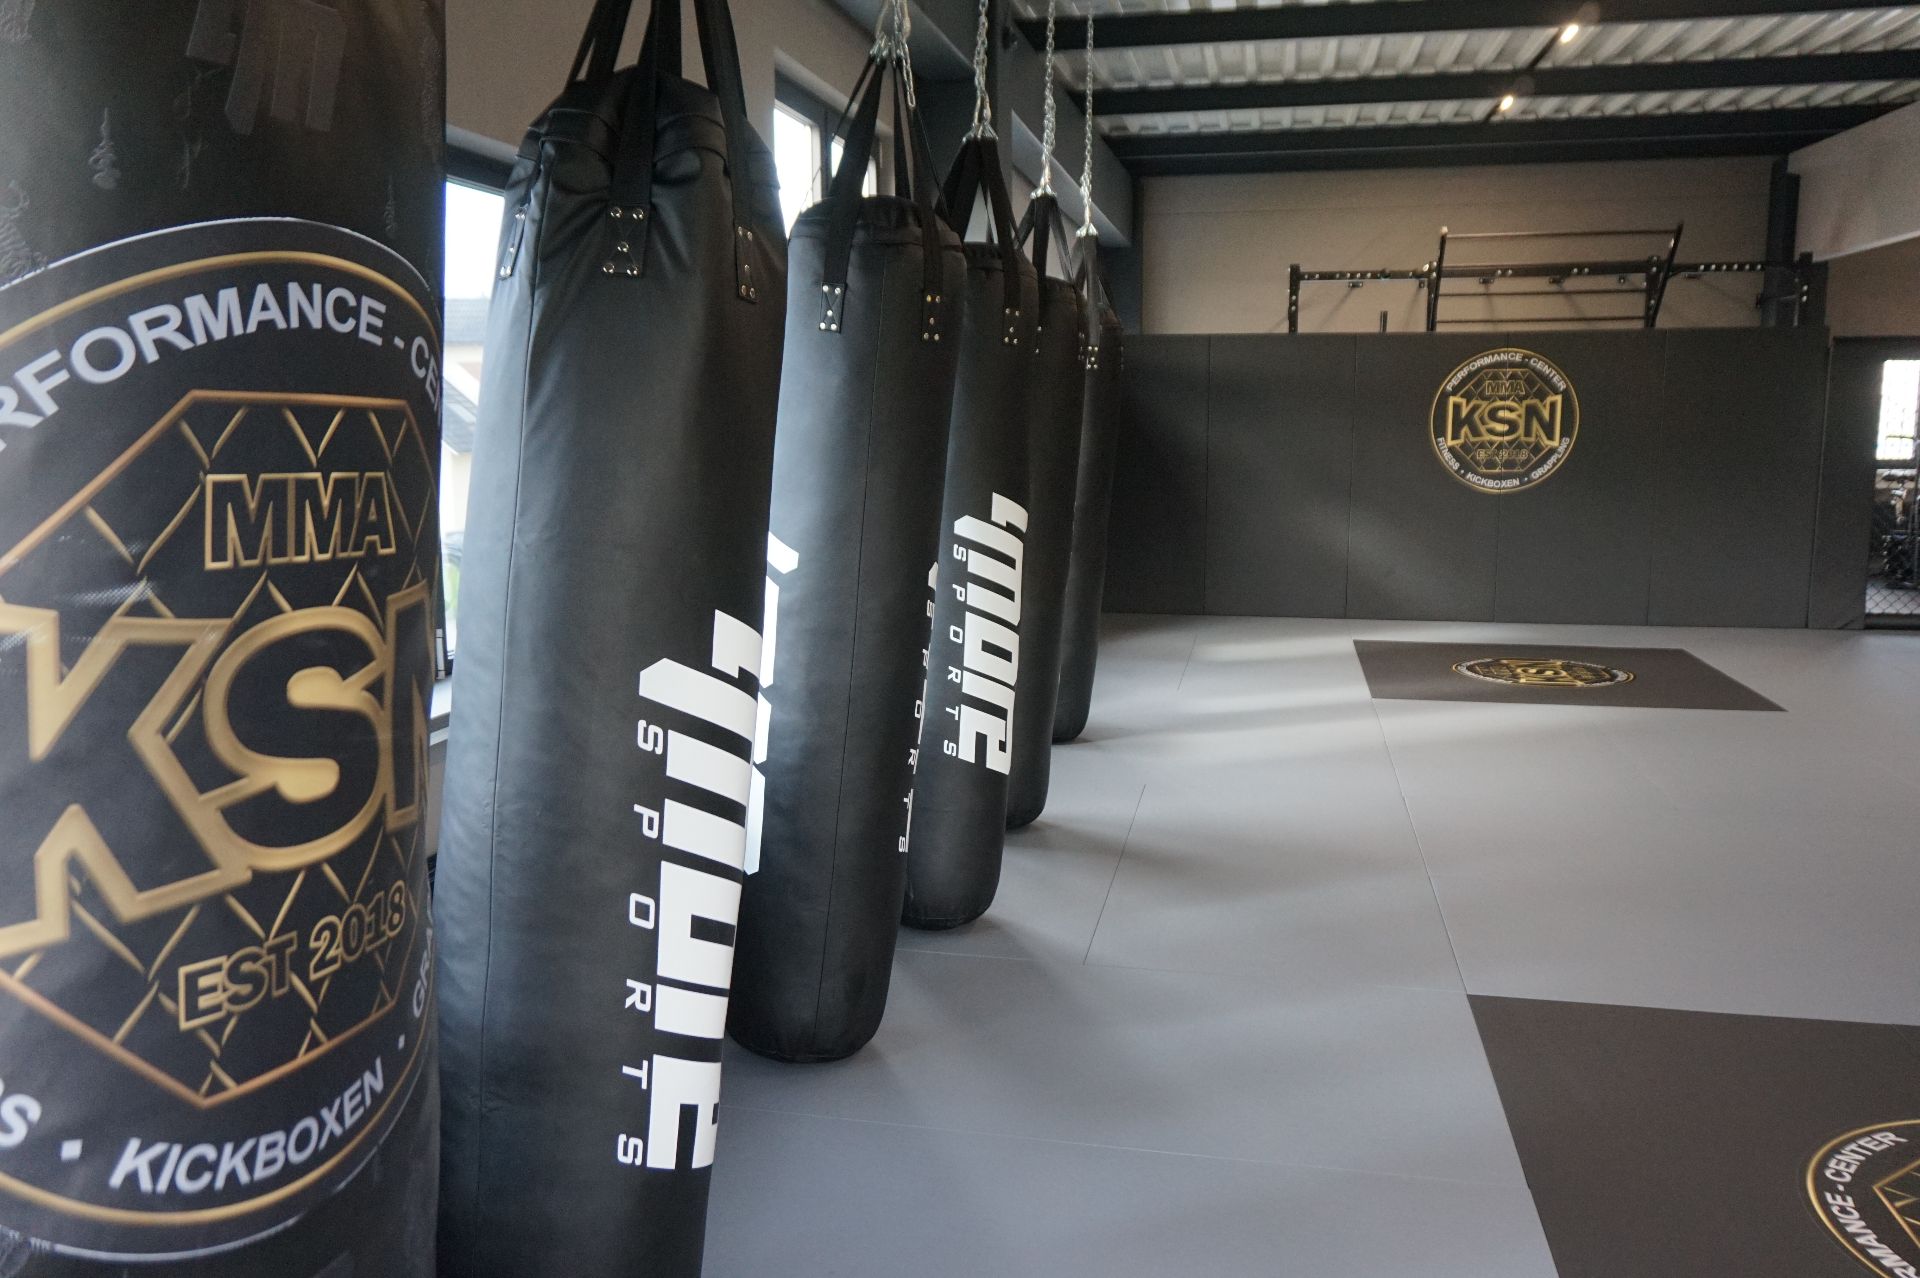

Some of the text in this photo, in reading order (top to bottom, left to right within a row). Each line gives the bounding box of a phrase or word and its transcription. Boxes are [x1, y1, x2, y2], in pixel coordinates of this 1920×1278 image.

[0, 281, 387, 453] RFORMANCE
[1446, 352, 1568, 392] PERFORMANCE CENTER
[1485, 380, 1526, 395] MMA
[1436, 436, 1570, 489] FITNESS KICKBOXEN GRAPPLING
[1446, 394, 1563, 447] KSN
[204, 471, 397, 570] MMA
[943, 543, 967, 758] SPORTS
[178, 880, 407, 1031] EST 2018
[617, 718, 664, 1168] SPORTS
[110, 1057, 385, 1194] KICKBOXEN
[1824, 1131, 1909, 1183] CENTER
